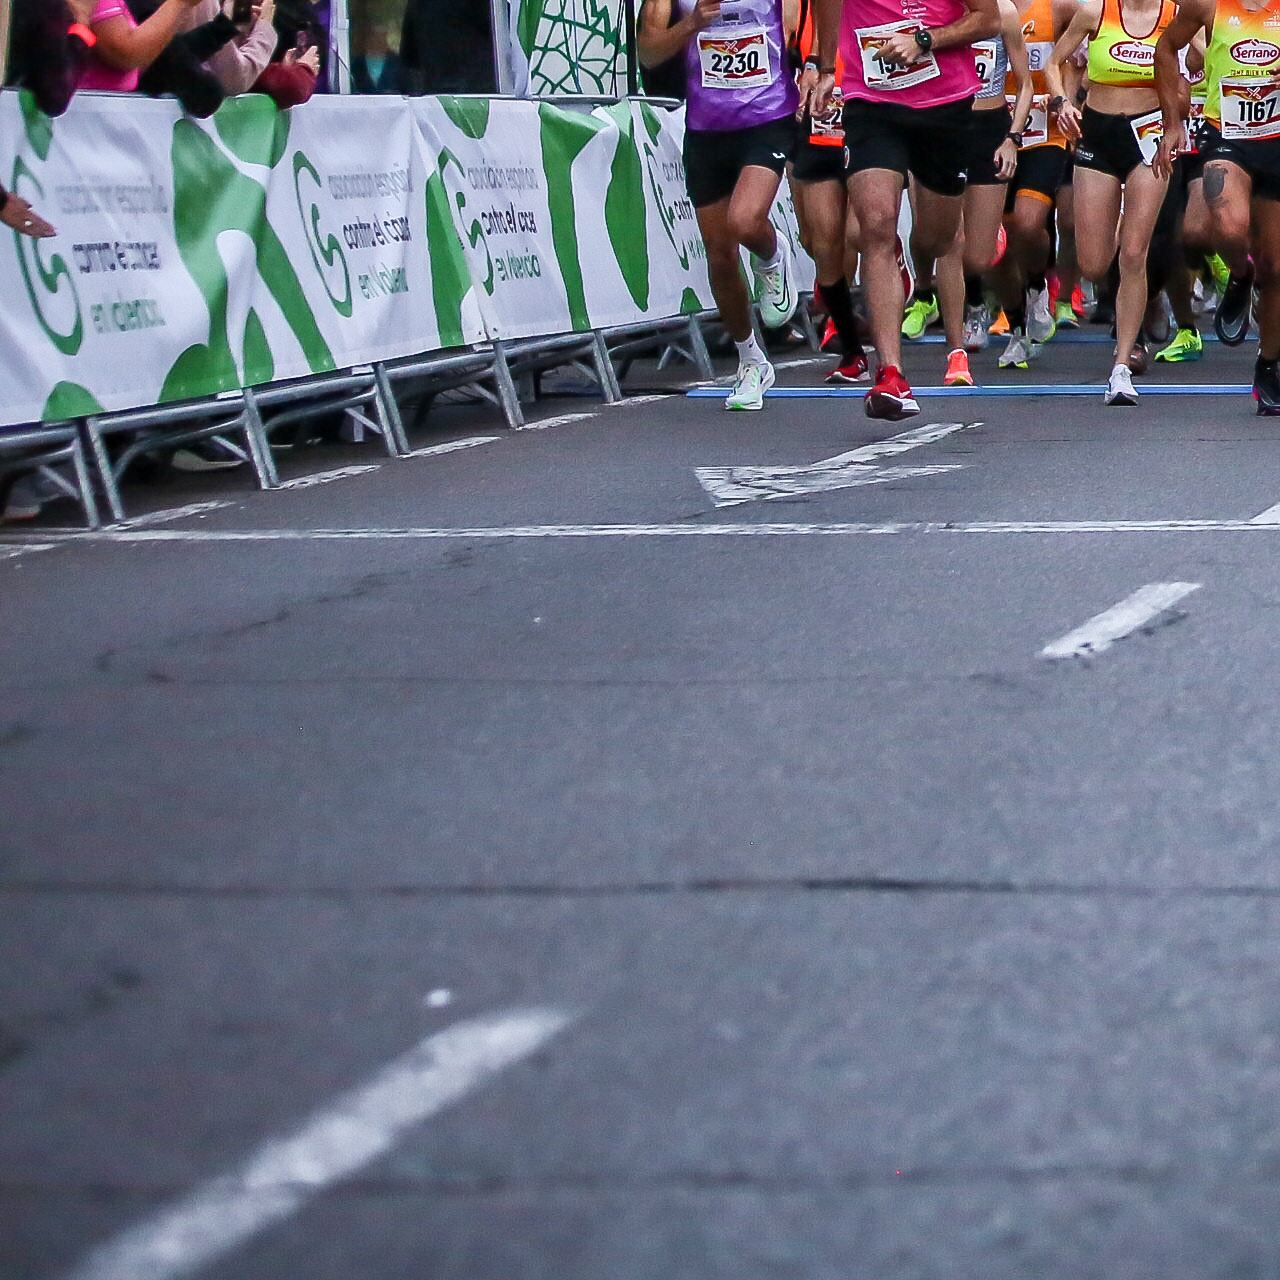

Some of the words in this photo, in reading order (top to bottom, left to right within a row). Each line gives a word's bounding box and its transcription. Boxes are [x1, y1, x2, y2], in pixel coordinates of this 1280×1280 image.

[1113, 45, 1155, 60] Serran
[1234, 46, 1278, 59] Serrano
[711, 51, 759, 73] 2230
[1238, 96, 1278, 122] 1167
